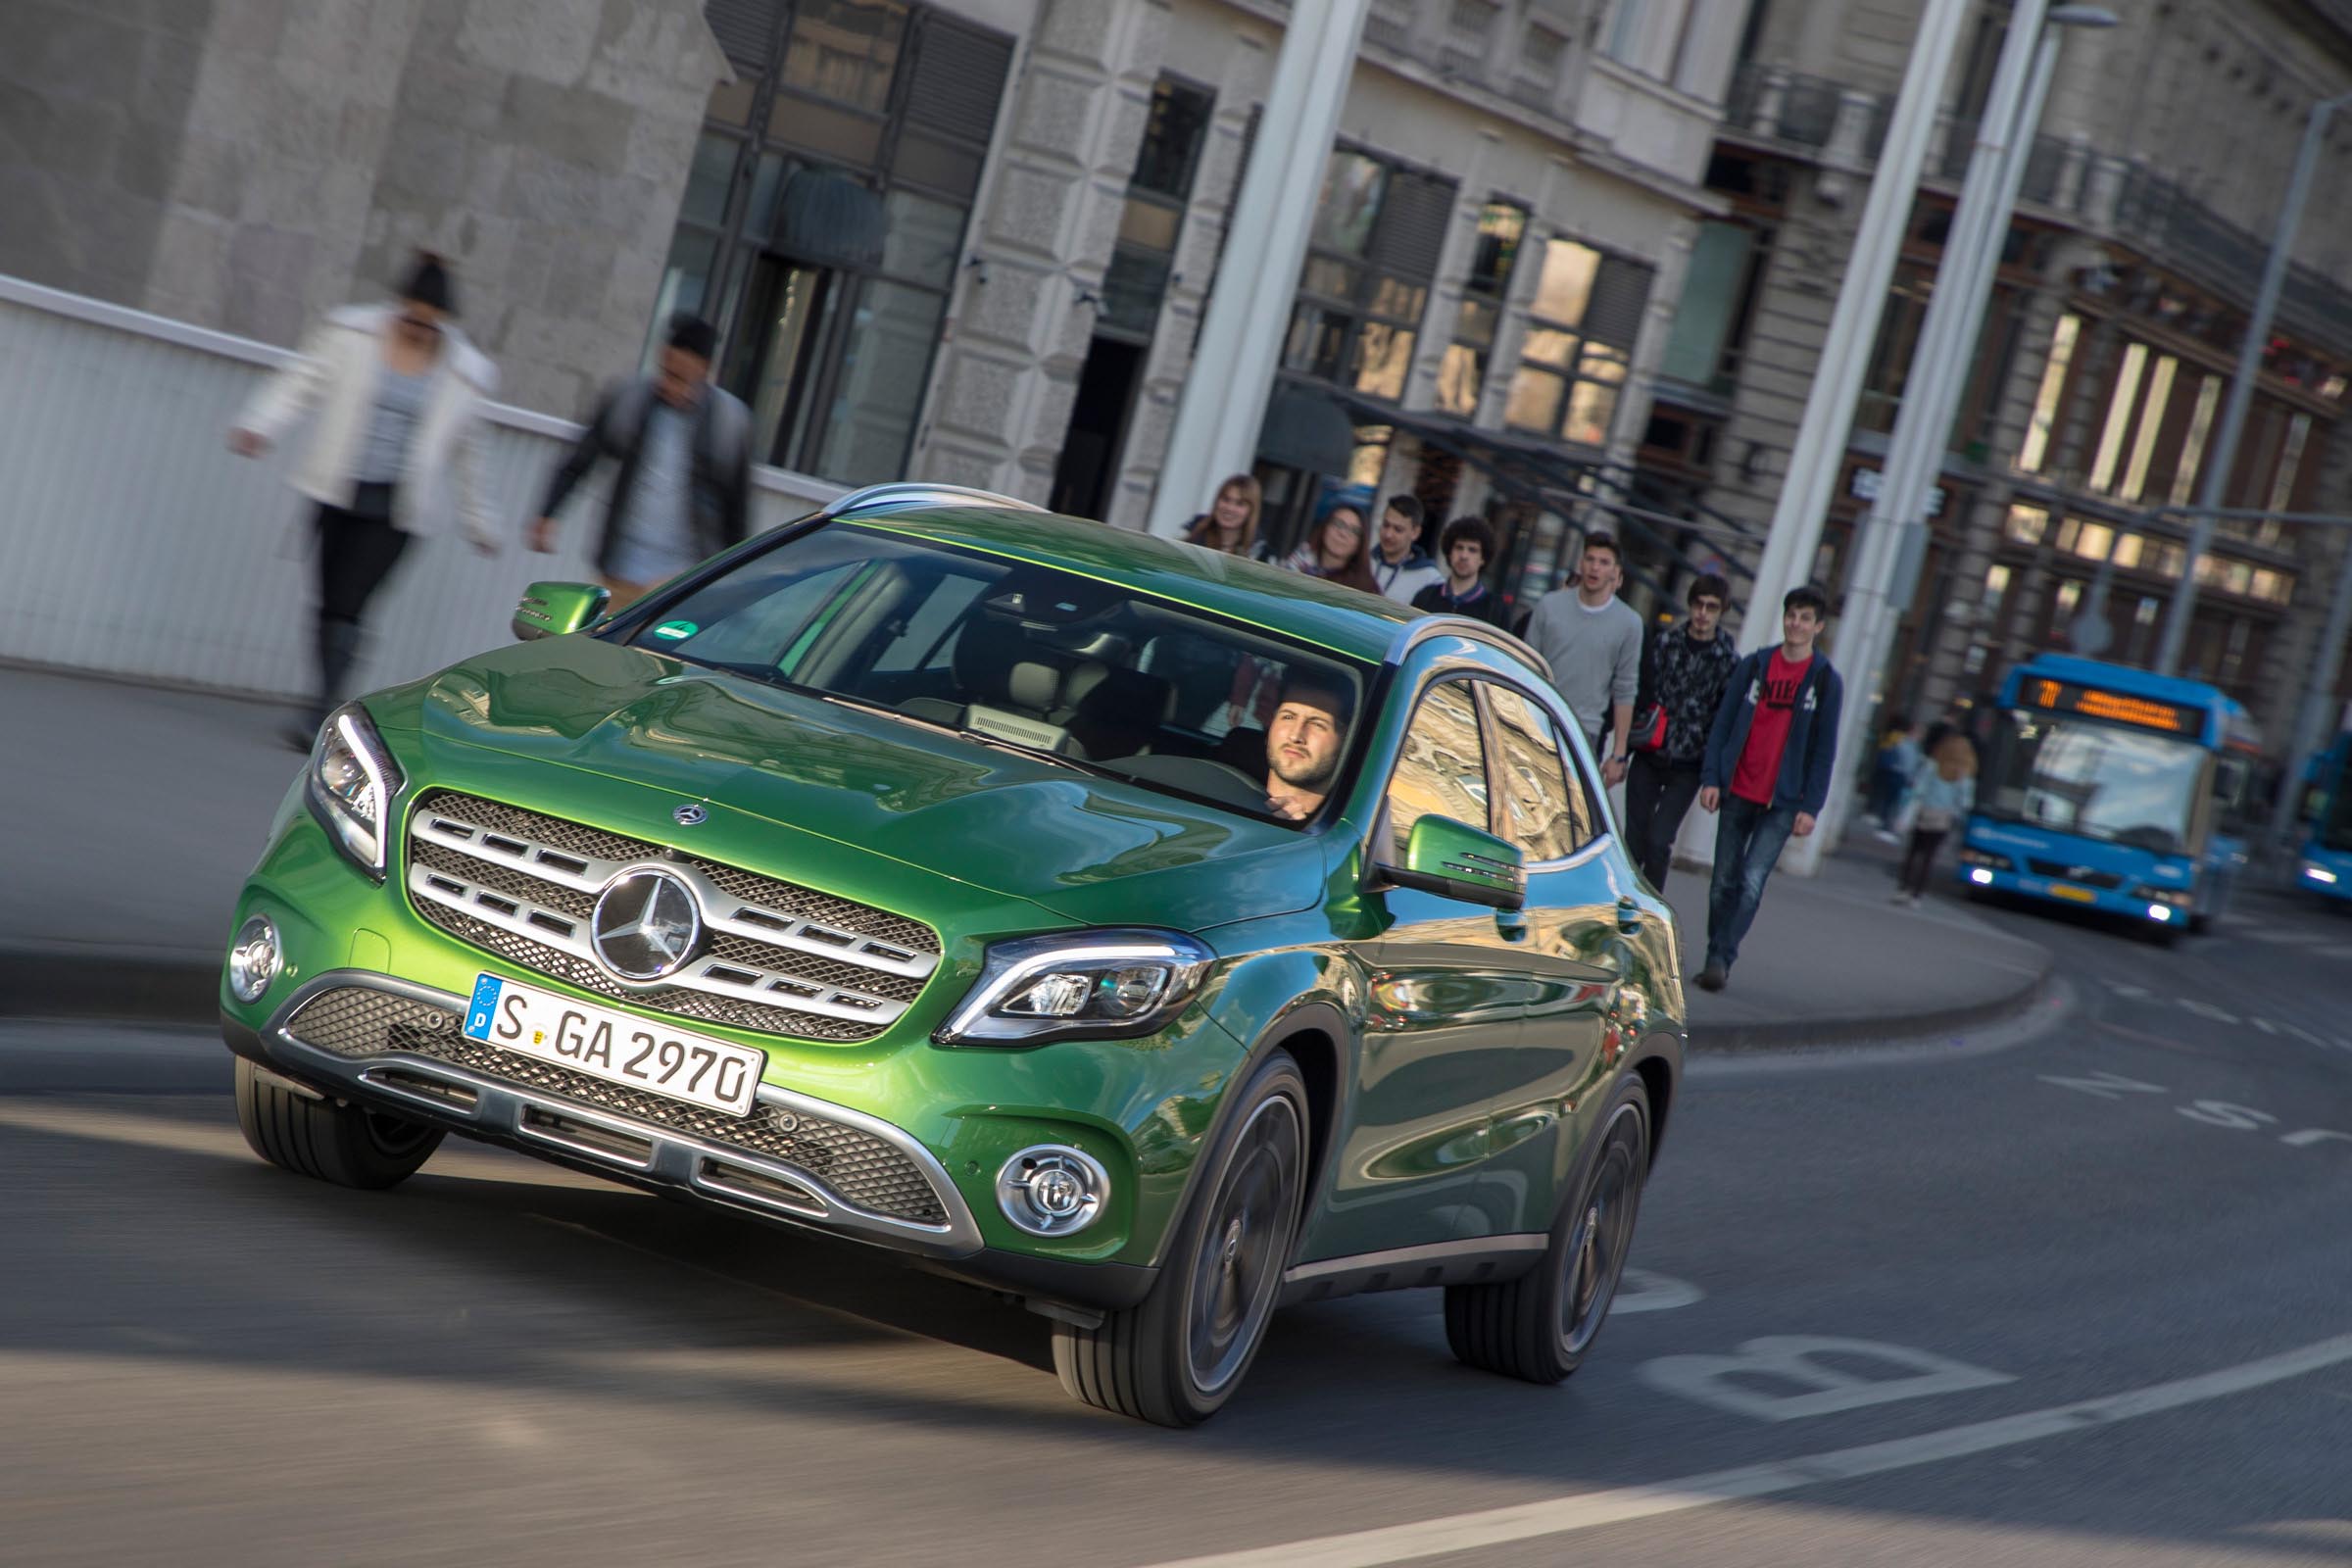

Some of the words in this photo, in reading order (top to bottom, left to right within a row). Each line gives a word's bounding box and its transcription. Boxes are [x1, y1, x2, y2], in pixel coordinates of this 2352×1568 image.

[473, 1012, 487, 1028] D
[496, 994, 527, 1040] S
[555, 1009, 613, 1069] GA
[622, 1030, 747, 1103] 2970
